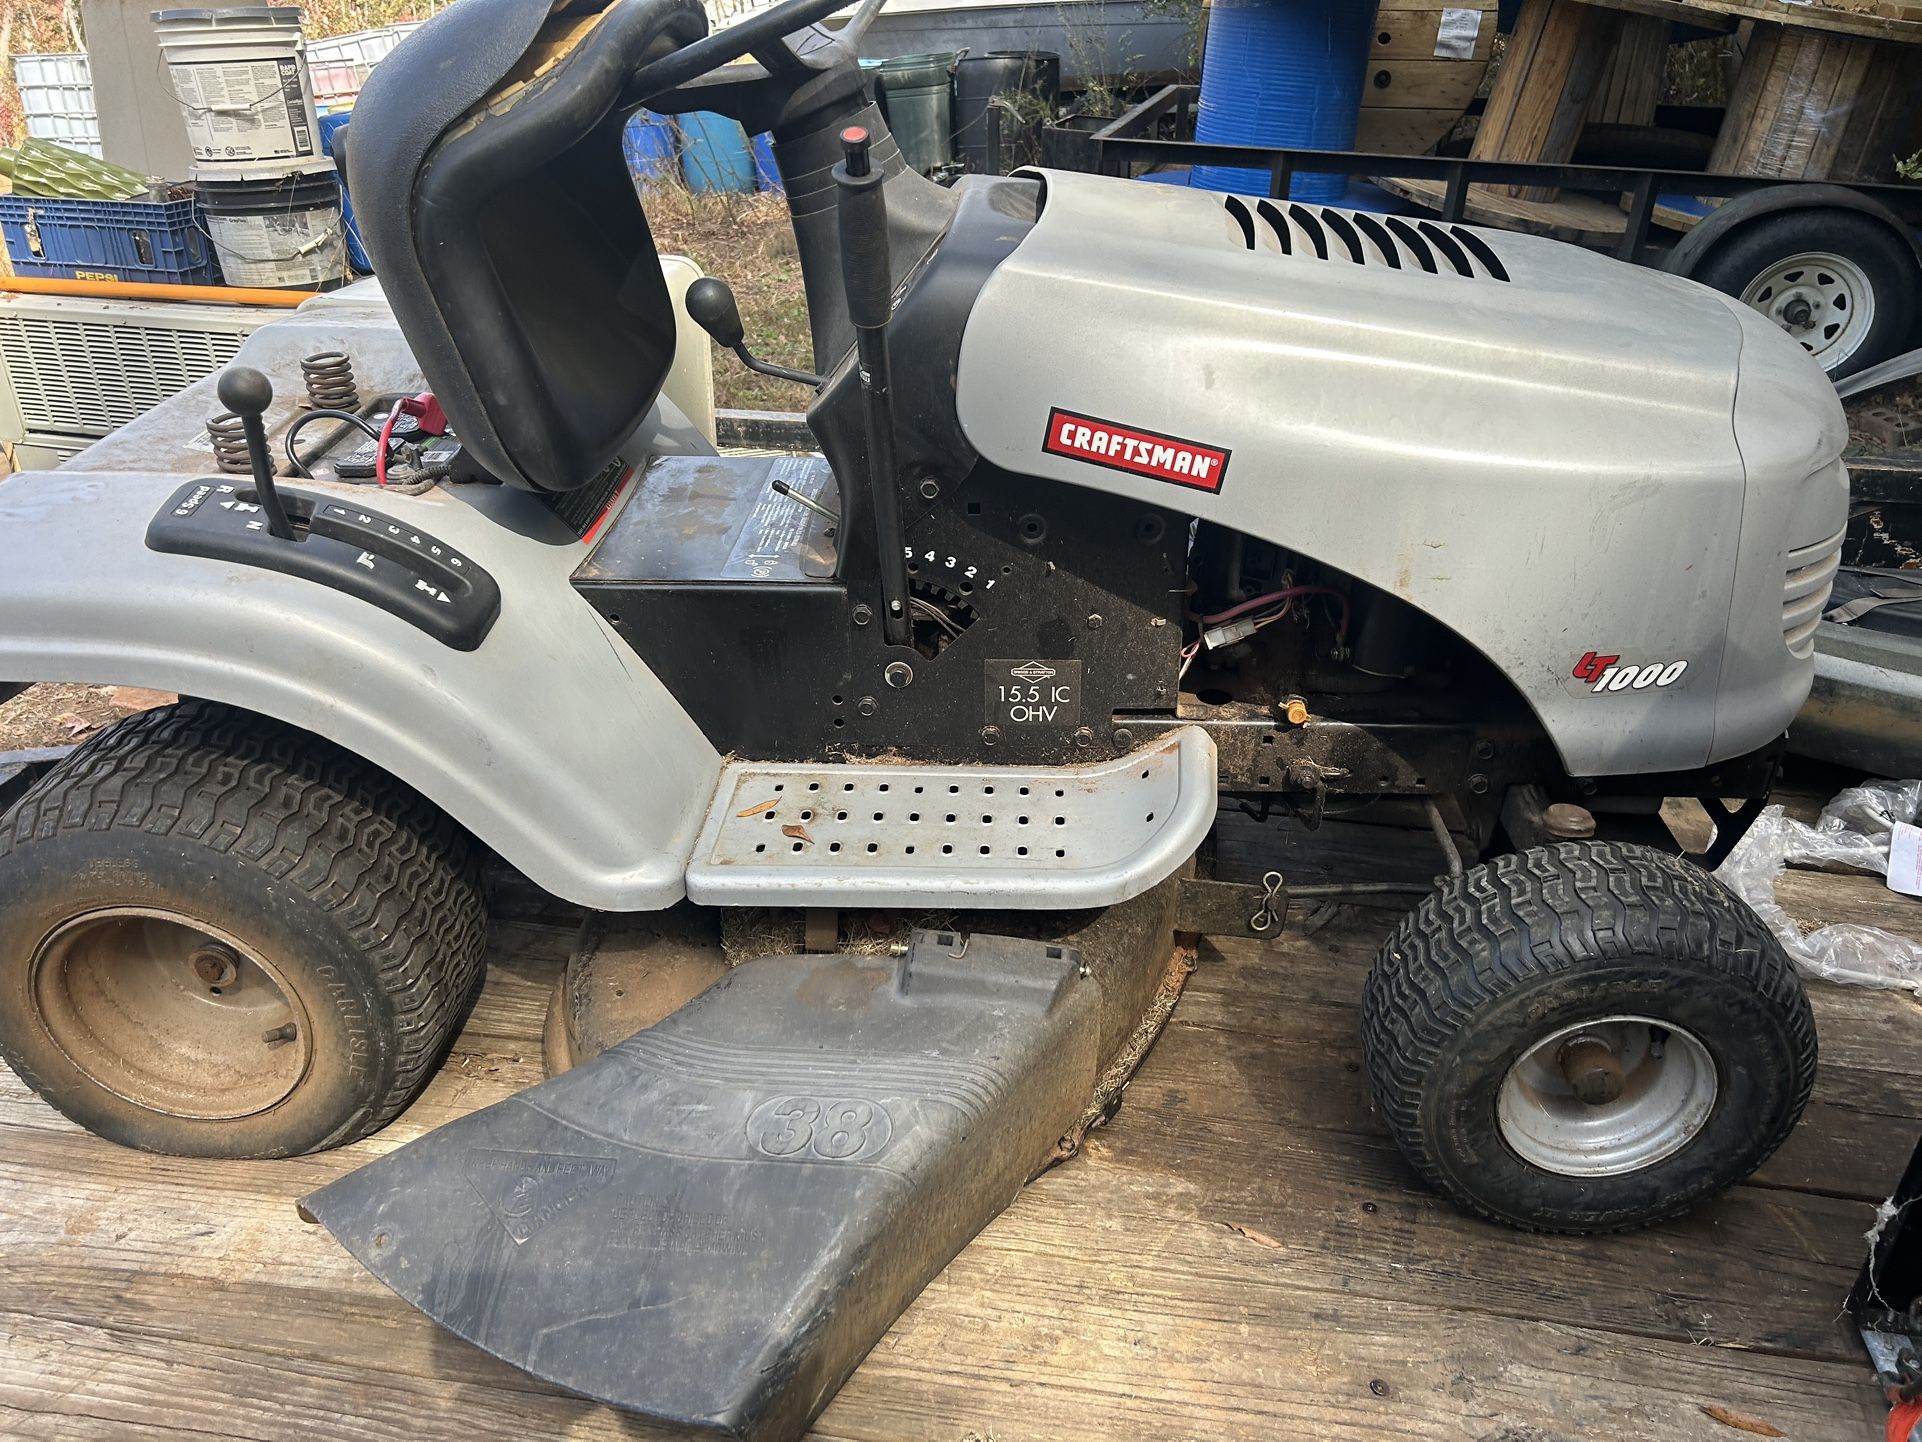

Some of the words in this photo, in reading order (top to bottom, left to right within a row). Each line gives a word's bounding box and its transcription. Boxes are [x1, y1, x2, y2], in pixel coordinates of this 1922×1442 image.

[75, 271, 119, 282] PEPSI
[182, 485, 211, 509] Speed
[216, 485, 234, 494] R
[358, 514, 371, 523] 2
[388, 525, 400, 534] 3
[410, 535, 421, 544] 4
[431, 545, 441, 555] 5
[450, 557, 462, 567] 6
[904, 546, 913, 558] 5
[924, 550, 935, 562] 4
[944, 556, 957, 568] 3
[963, 566, 977, 578] 2
[985, 579, 996, 589] 1
[999, 685, 1040, 703] 15.5
[1051, 686, 1071, 703] IC
[1010, 705, 1058, 722] OHV
[760, 1097, 874, 1160] 38
